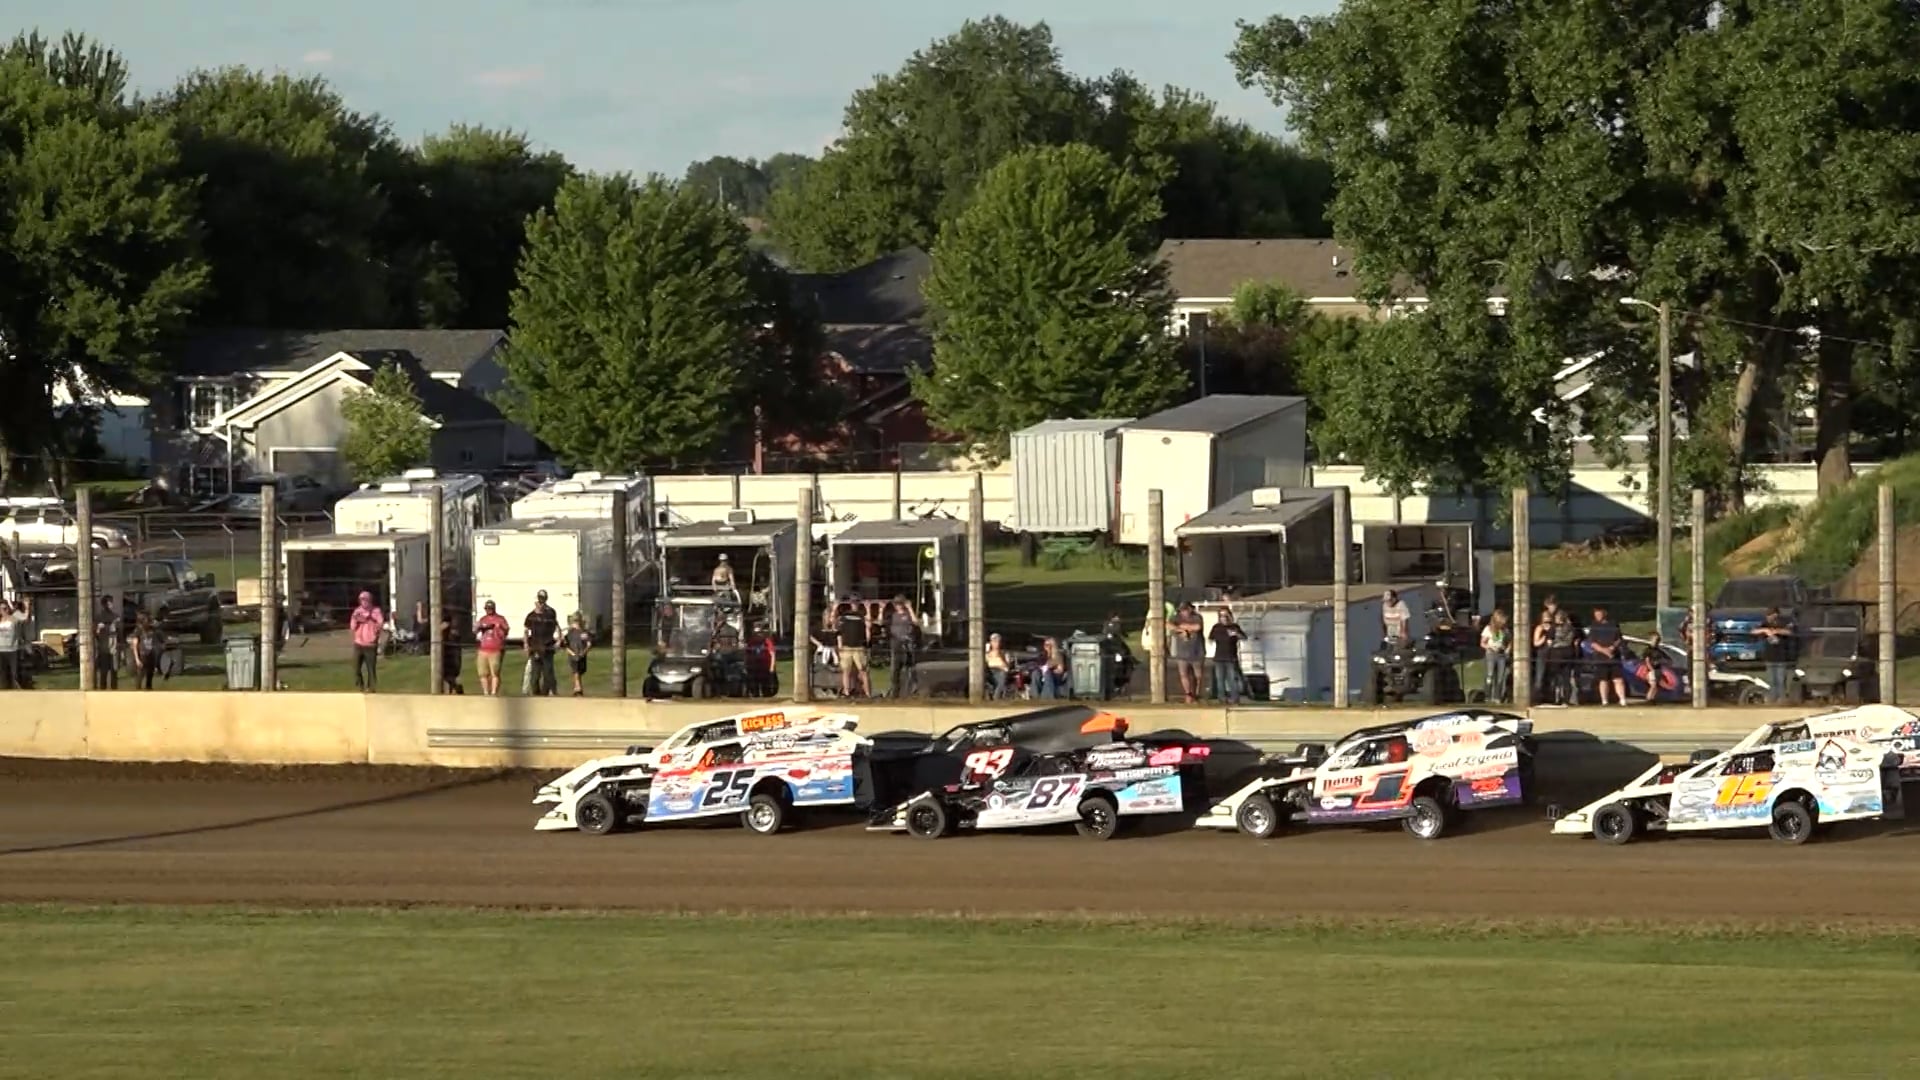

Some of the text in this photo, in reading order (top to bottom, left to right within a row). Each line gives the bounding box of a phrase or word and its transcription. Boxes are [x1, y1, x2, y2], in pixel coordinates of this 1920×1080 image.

[742, 713, 784, 731] KICKASS
[1813, 729, 1857, 739] MURPHY
[965, 748, 1014, 779] 93
[1426, 750, 1513, 772] Local Legends
[703, 768, 756, 807] 25
[1025, 776, 1081, 810] 87
[1713, 772, 1775, 807] 15
